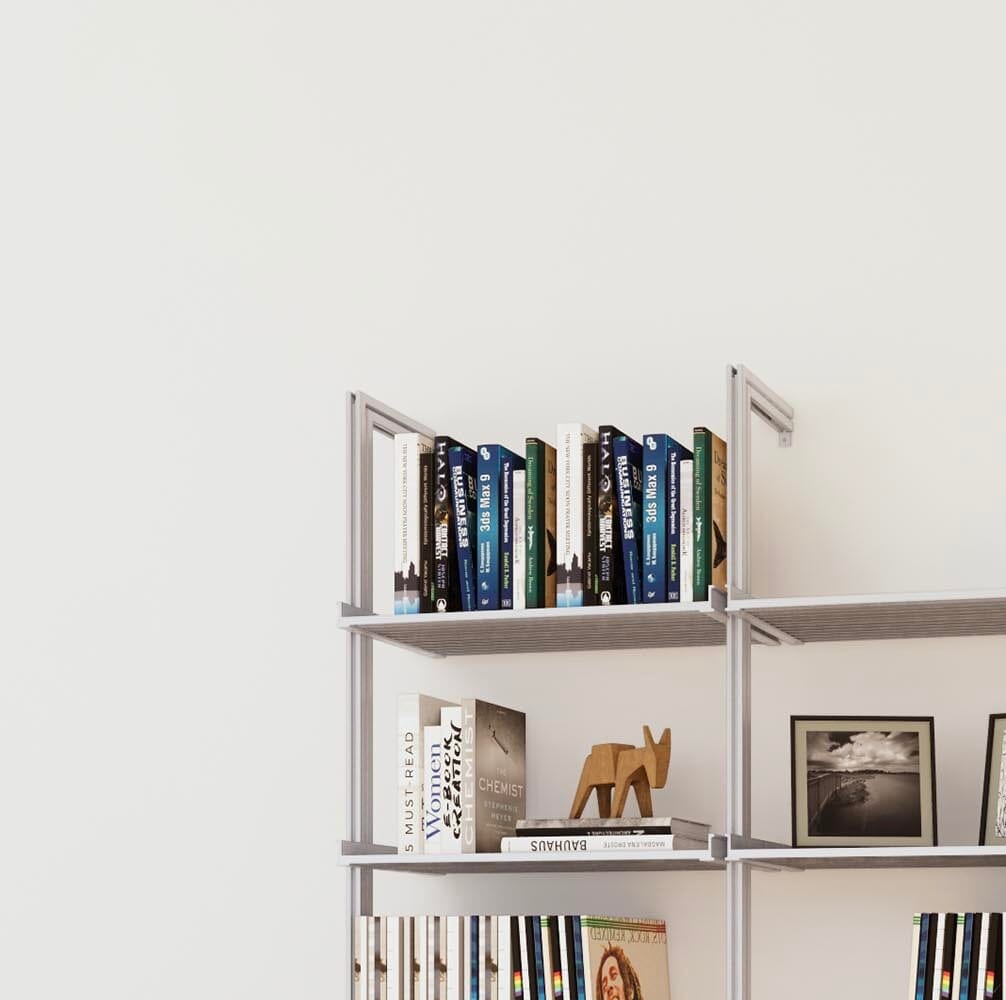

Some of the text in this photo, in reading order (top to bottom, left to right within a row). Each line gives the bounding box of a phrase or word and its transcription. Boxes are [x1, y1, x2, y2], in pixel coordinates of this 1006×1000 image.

[437, 442, 446, 502] HALO
[480, 474, 490, 482] 9
[600, 432, 610, 492] HALO
[694, 446, 702, 478] Dreaming
[456, 465, 469, 548] BUSINESS
[480, 484, 490, 508] Max
[622, 456, 634, 540] BUSINESS
[646, 475, 656, 499] Max
[694, 486, 702, 510] Sweden
[480, 512, 491, 532] 3ds
[646, 502, 657, 523] 3ds
[405, 732, 414, 852] 5 MUST-READ
[426, 744, 441, 840] Women
[443, 732, 452, 828] E-BOOK
[450, 720, 462, 839] CREATION
[464, 708, 474, 845] CHEMIST
[478, 778, 524, 798] CHEMIST
[531, 840, 587, 852] BAUHAUS
